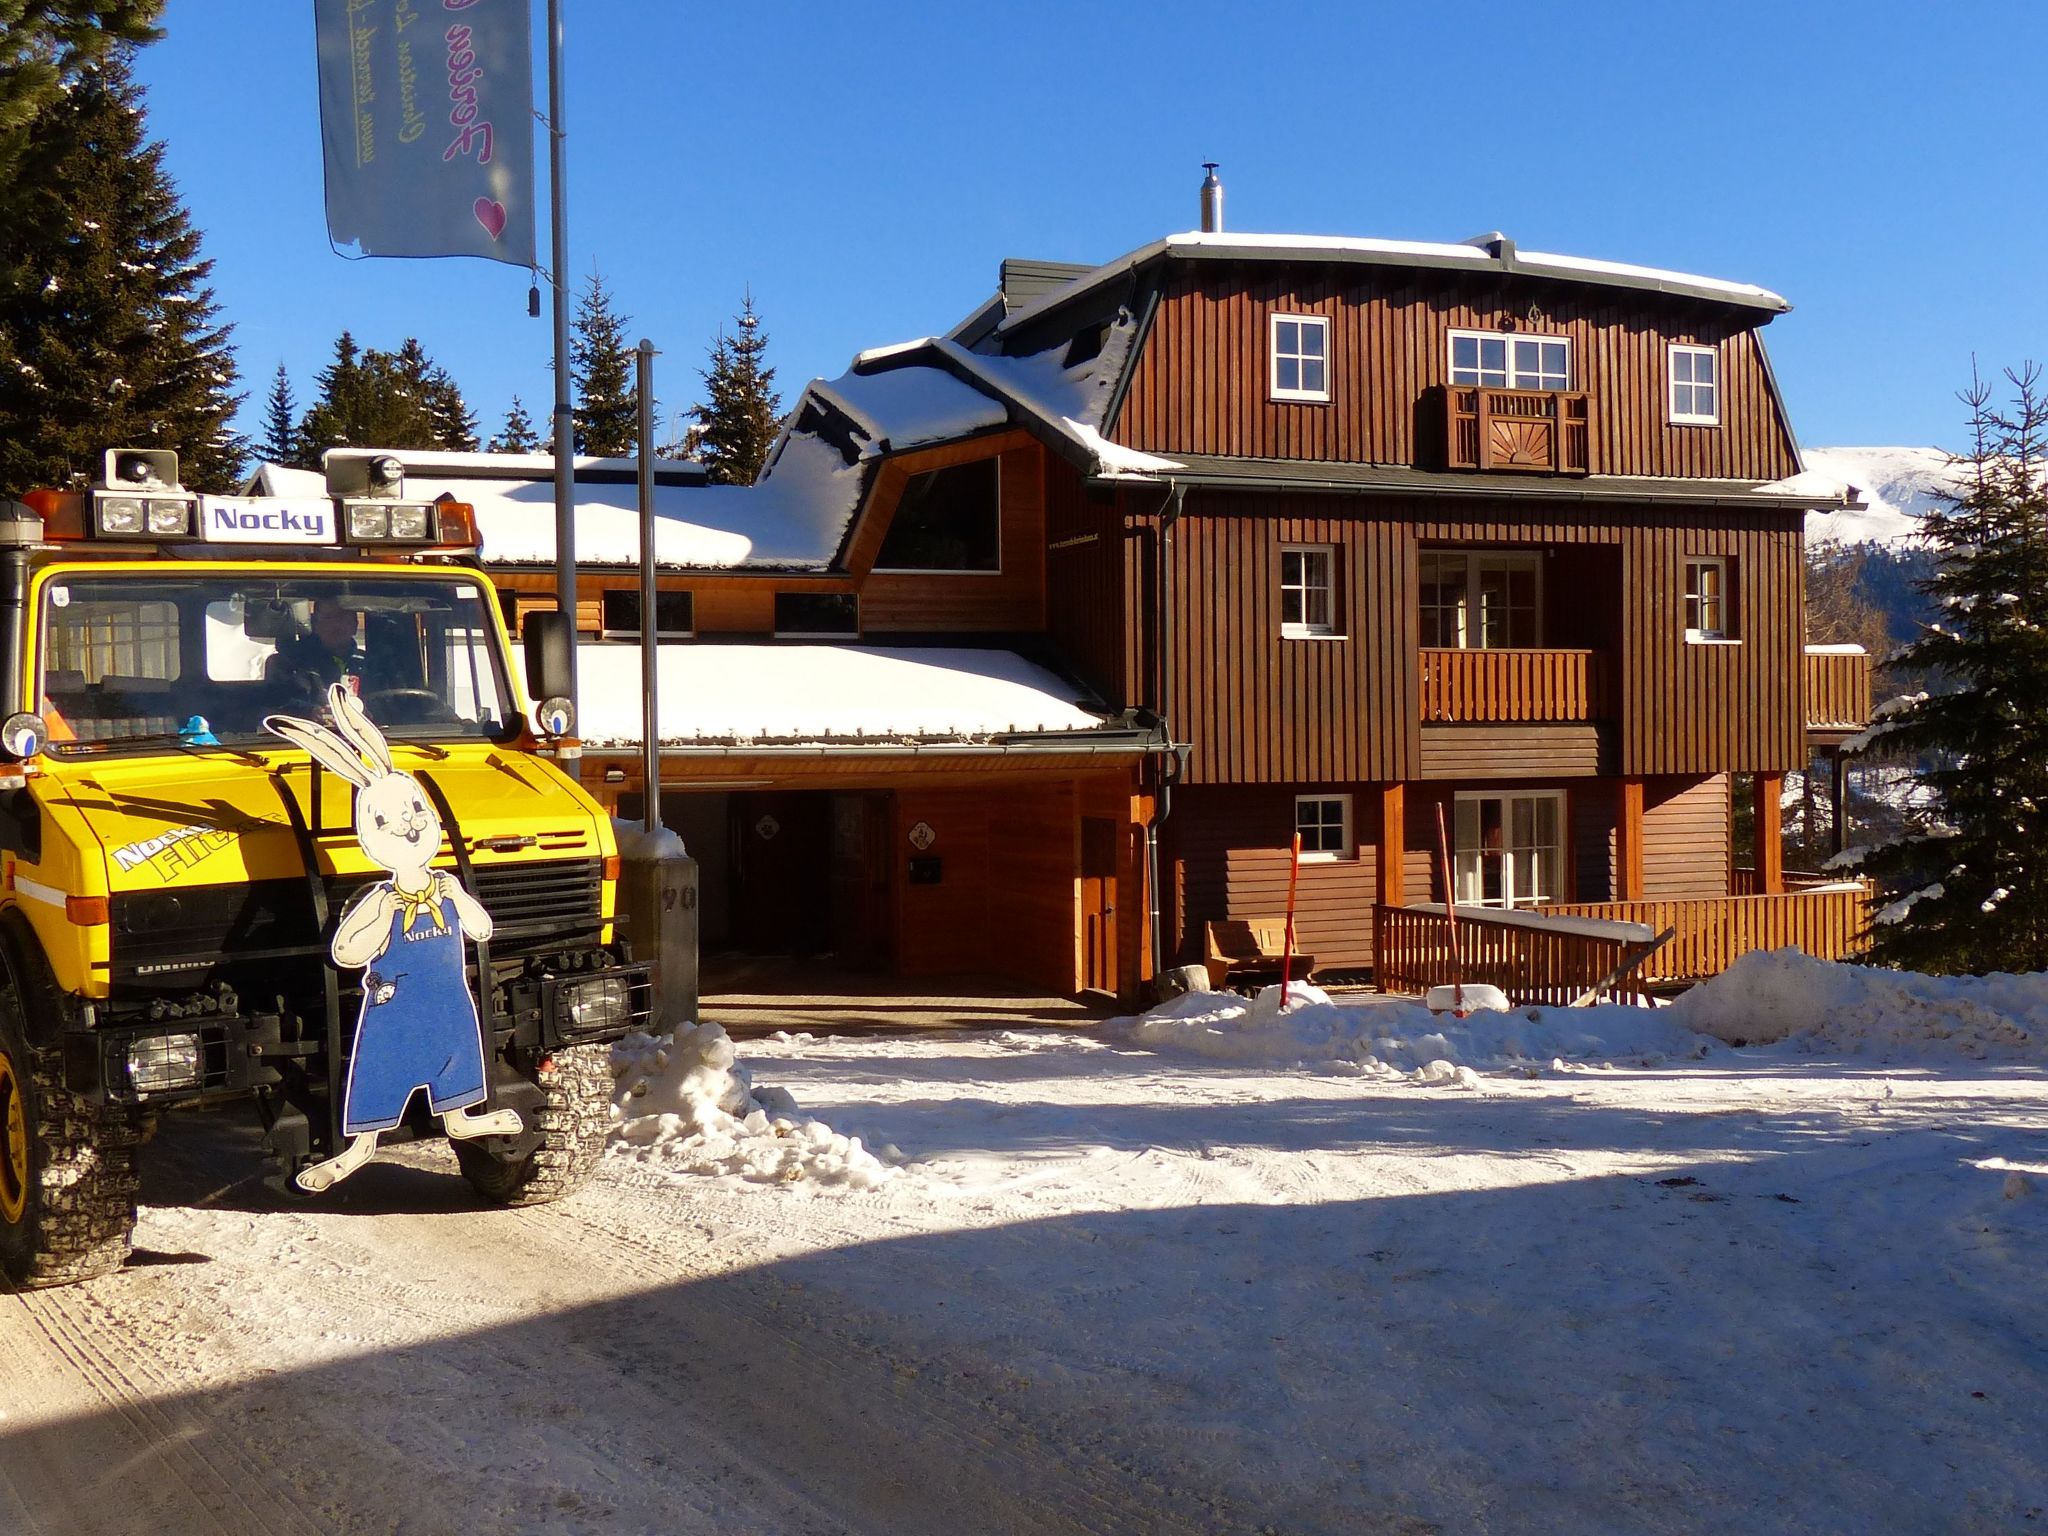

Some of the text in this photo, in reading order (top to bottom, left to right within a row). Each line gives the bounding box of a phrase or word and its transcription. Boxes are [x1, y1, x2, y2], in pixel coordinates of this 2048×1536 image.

[214, 508, 324, 536] Nocky
[111, 822, 217, 872] Nocky
[403, 925, 452, 943] Nocky
